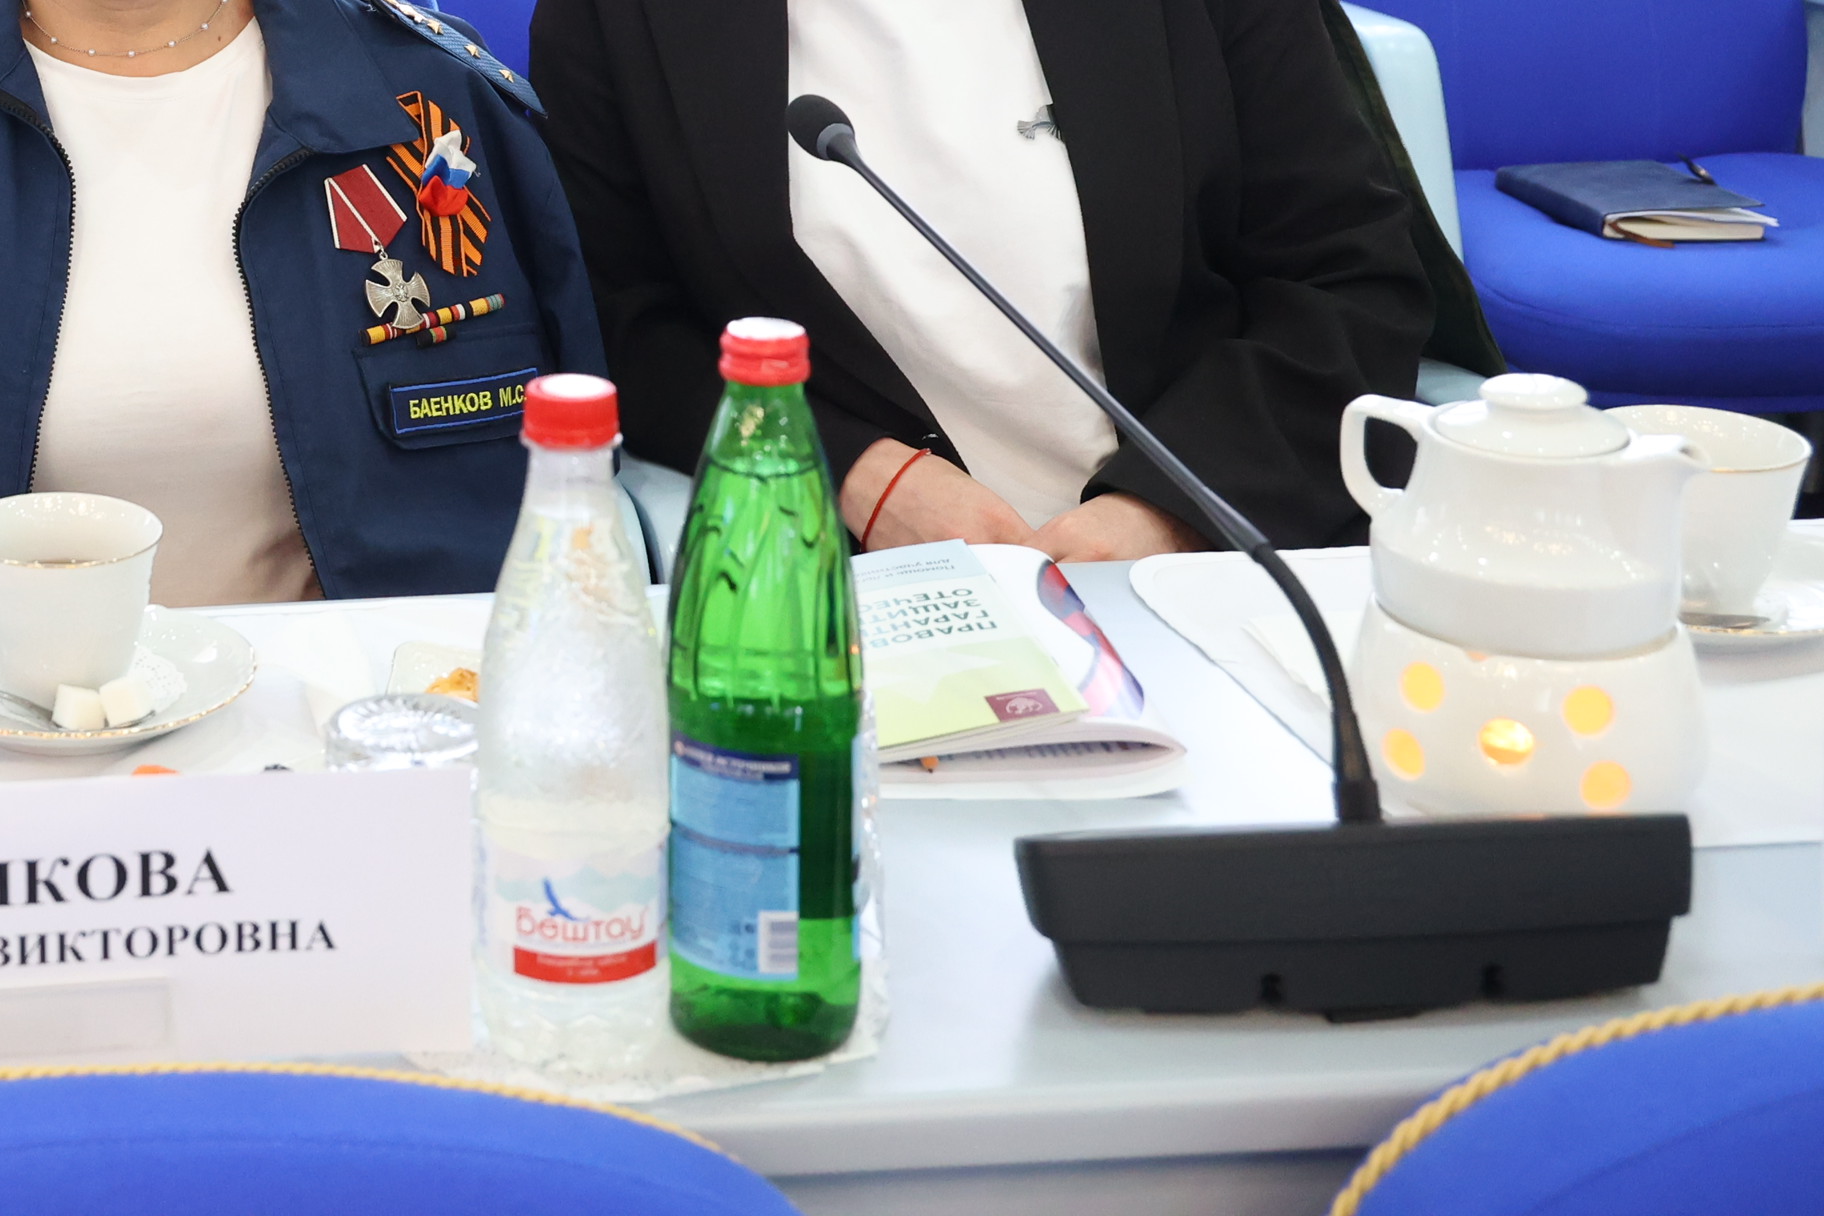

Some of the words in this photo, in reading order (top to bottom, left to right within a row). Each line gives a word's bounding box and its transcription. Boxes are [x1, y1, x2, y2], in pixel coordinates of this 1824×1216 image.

[409, 389, 492, 419] БАЕНКОВ
[499, 384, 526, 408] М.С.
[860, 598, 981, 625] ЗАЩИТ
[862, 620, 998, 650] ПРАВОВ
